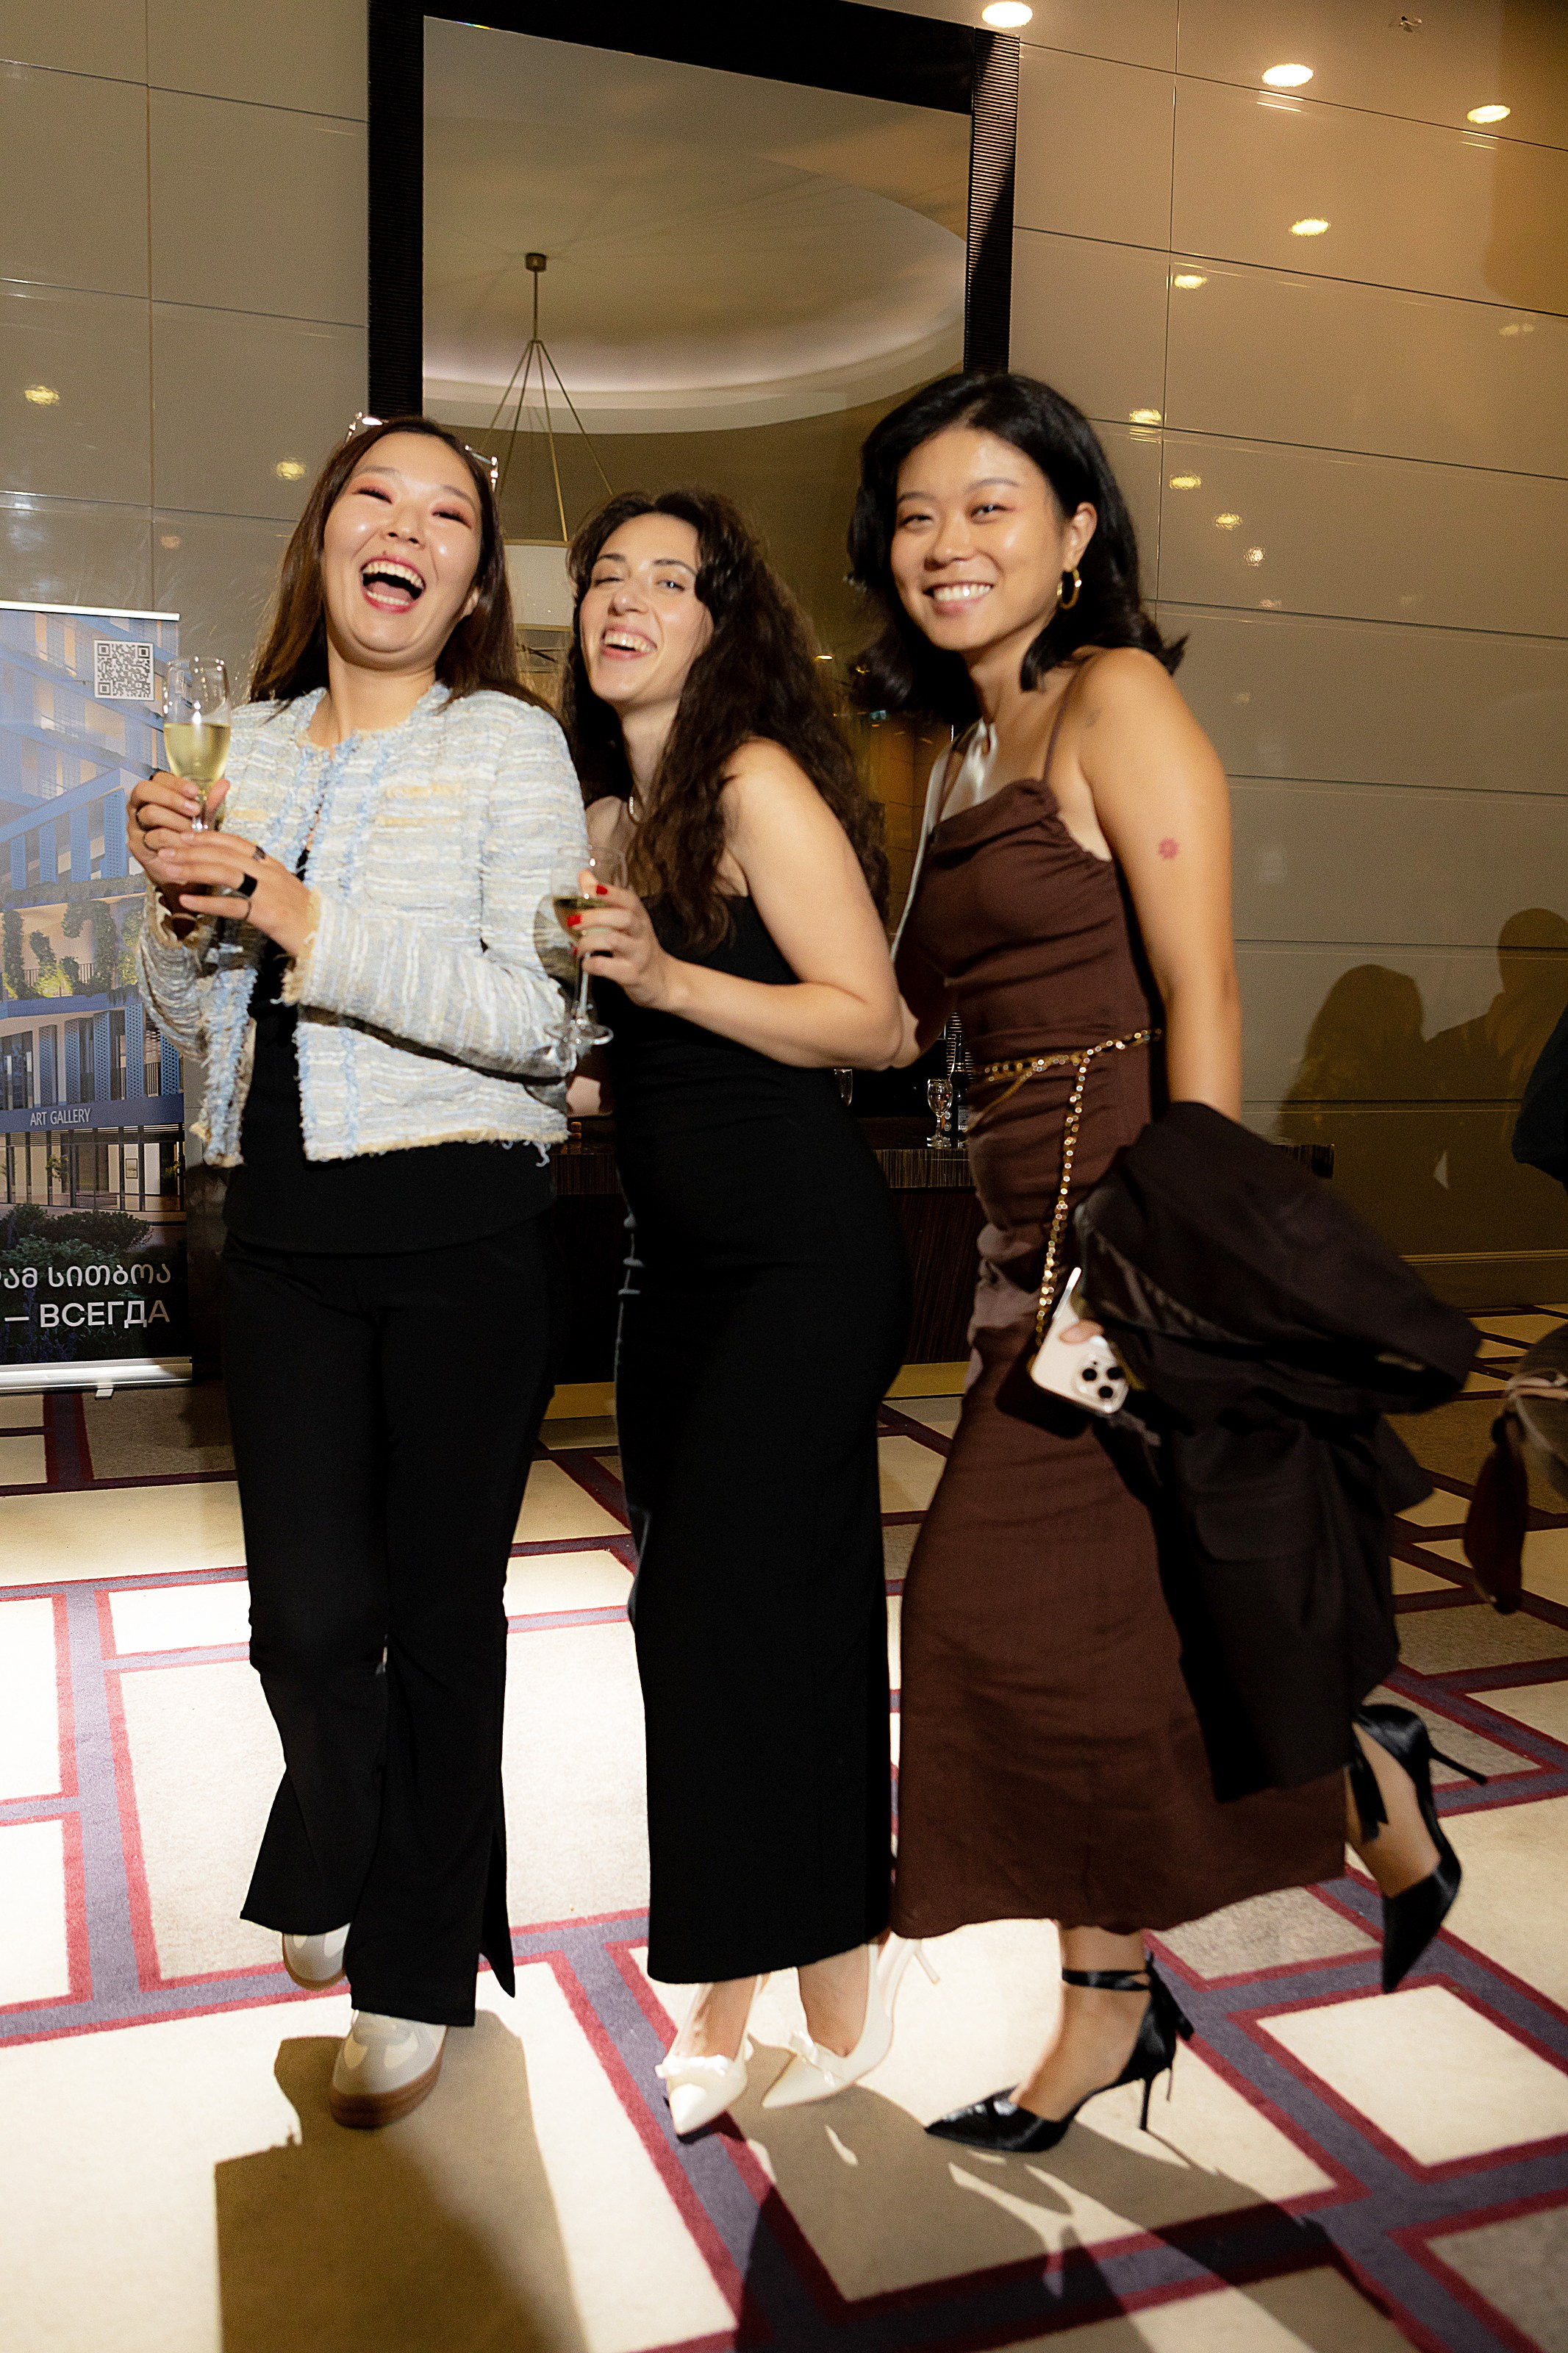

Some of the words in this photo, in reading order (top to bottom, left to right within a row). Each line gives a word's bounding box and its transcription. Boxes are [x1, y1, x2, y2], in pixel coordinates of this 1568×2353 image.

[30, 1112, 47, 1126] ART
[50, 1108, 90, 1124] GALLERY
[0, 1267, 38, 1288] ამ
[48, 1263, 171, 1287] სითბოა
[40, 1299, 170, 1328] ВСЕГДА
